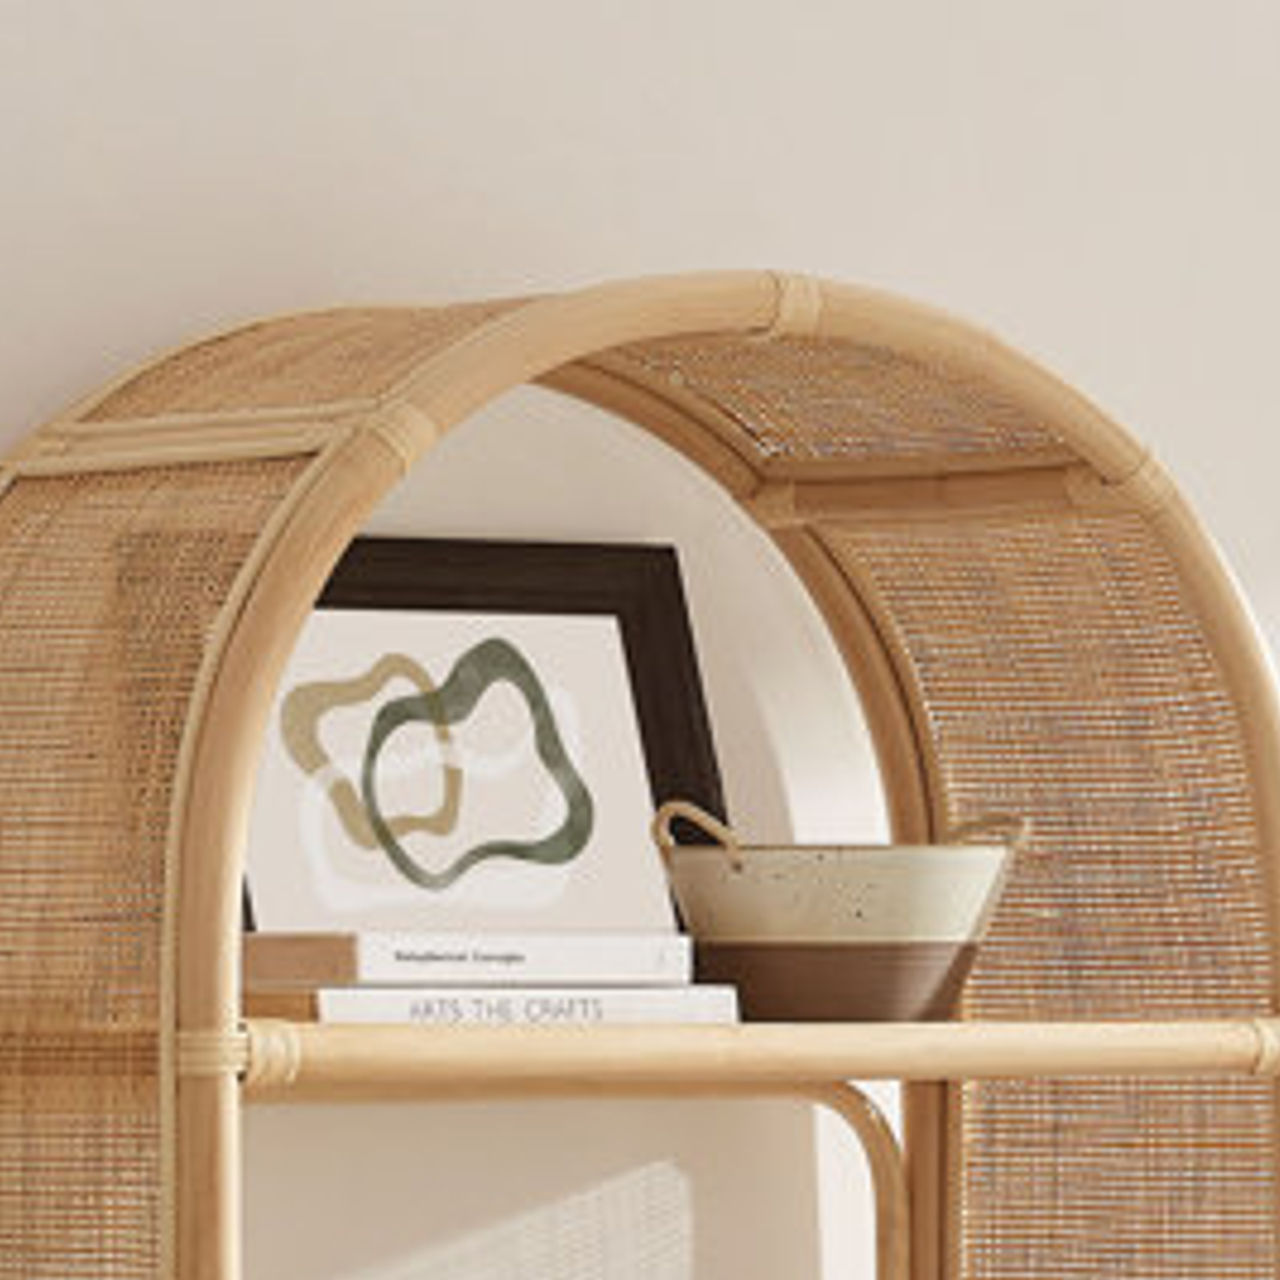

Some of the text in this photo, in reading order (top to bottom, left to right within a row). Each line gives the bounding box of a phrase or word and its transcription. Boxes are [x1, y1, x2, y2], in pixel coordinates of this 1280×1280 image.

[409, 998, 604, 1019] ARTS THE CRAFTS
